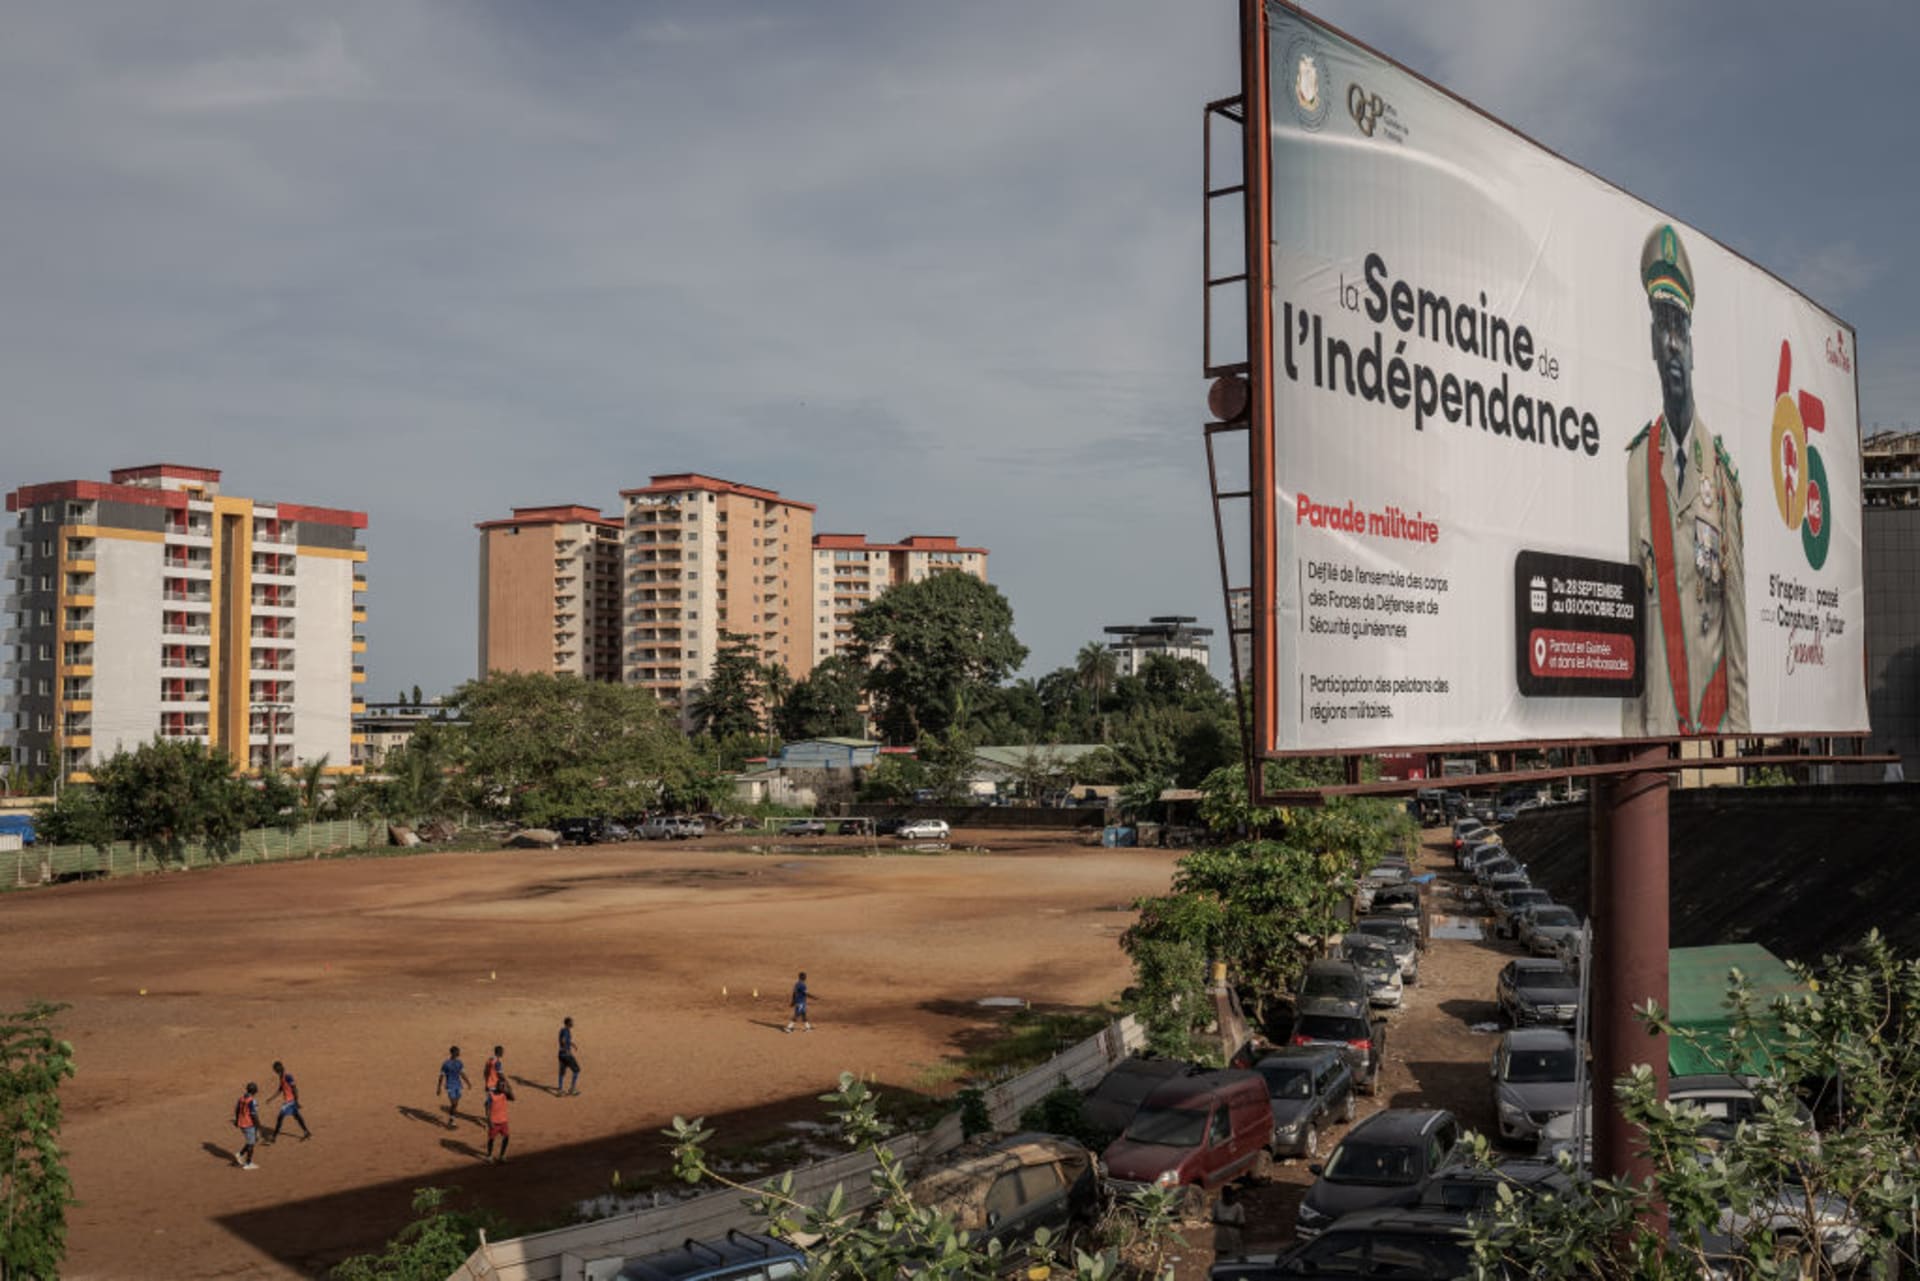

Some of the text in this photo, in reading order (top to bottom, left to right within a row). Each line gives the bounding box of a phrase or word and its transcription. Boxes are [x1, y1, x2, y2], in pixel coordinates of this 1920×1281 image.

[1339, 252, 1559, 380] la Semaine de
[1283, 301, 1600, 457] l'Indépendance
[1296, 492, 1440, 544] Parade militaire
[1308, 561, 1448, 594] Défilé de l'ensemble des corps
[1552, 577, 1565, 594] Du
[1578, 580, 1624, 600] SEPTEMBRE
[1308, 588, 1439, 616] des Forces de Défense et de
[1552, 601, 1564, 613] au
[1577, 600, 1615, 617] OCTOBRE
[1309, 615, 1407, 640] Sécurité guinéennes
[1310, 674, 1449, 696] Participation des pelotons des
[1310, 701, 1347, 724] régions
